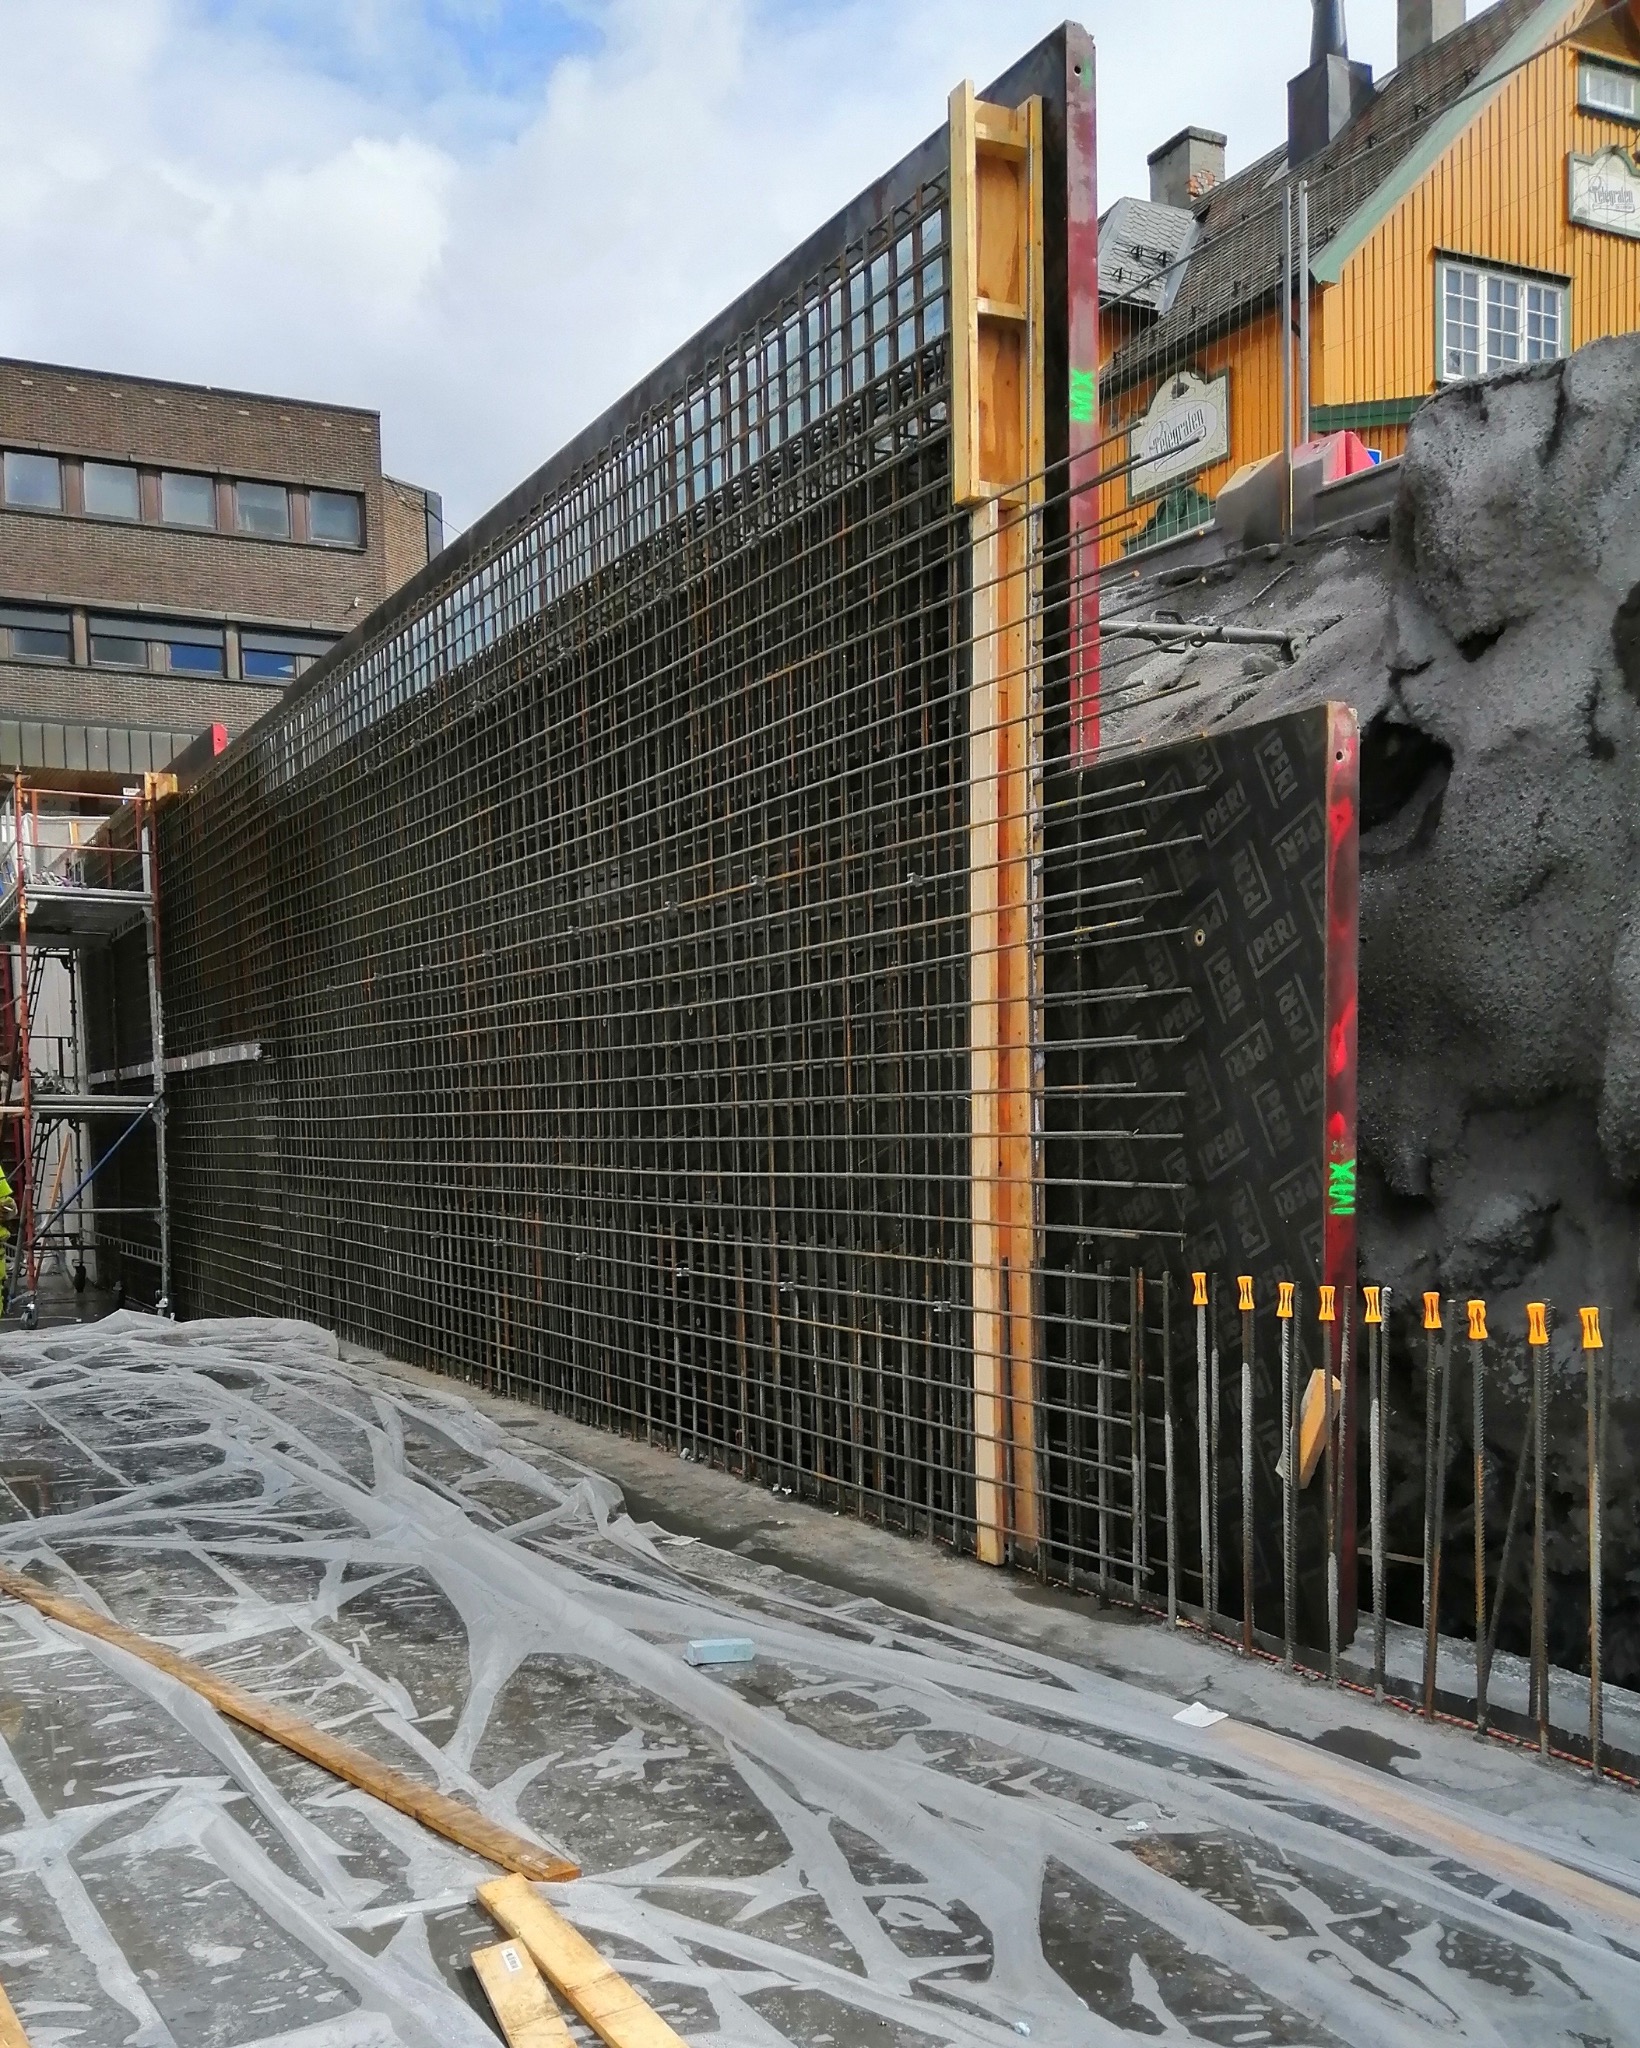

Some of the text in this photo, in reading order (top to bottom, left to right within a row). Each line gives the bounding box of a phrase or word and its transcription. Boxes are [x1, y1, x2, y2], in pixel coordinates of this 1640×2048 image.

[1149, 409, 1204, 454] Telegrafen
[1264, 736, 1298, 801] PERI
[1205, 779, 1246, 835] PERI
[1276, 815, 1323, 871] PERI
[1253, 910, 1297, 964] PERI
[1213, 956, 1246, 1017] PERI
[1275, 979, 1310, 1042] PERI
[1225, 1034, 1267, 1083] PERI
[1205, 1120, 1246, 1168] PERI
[1275, 1172, 1319, 1217] PERI
